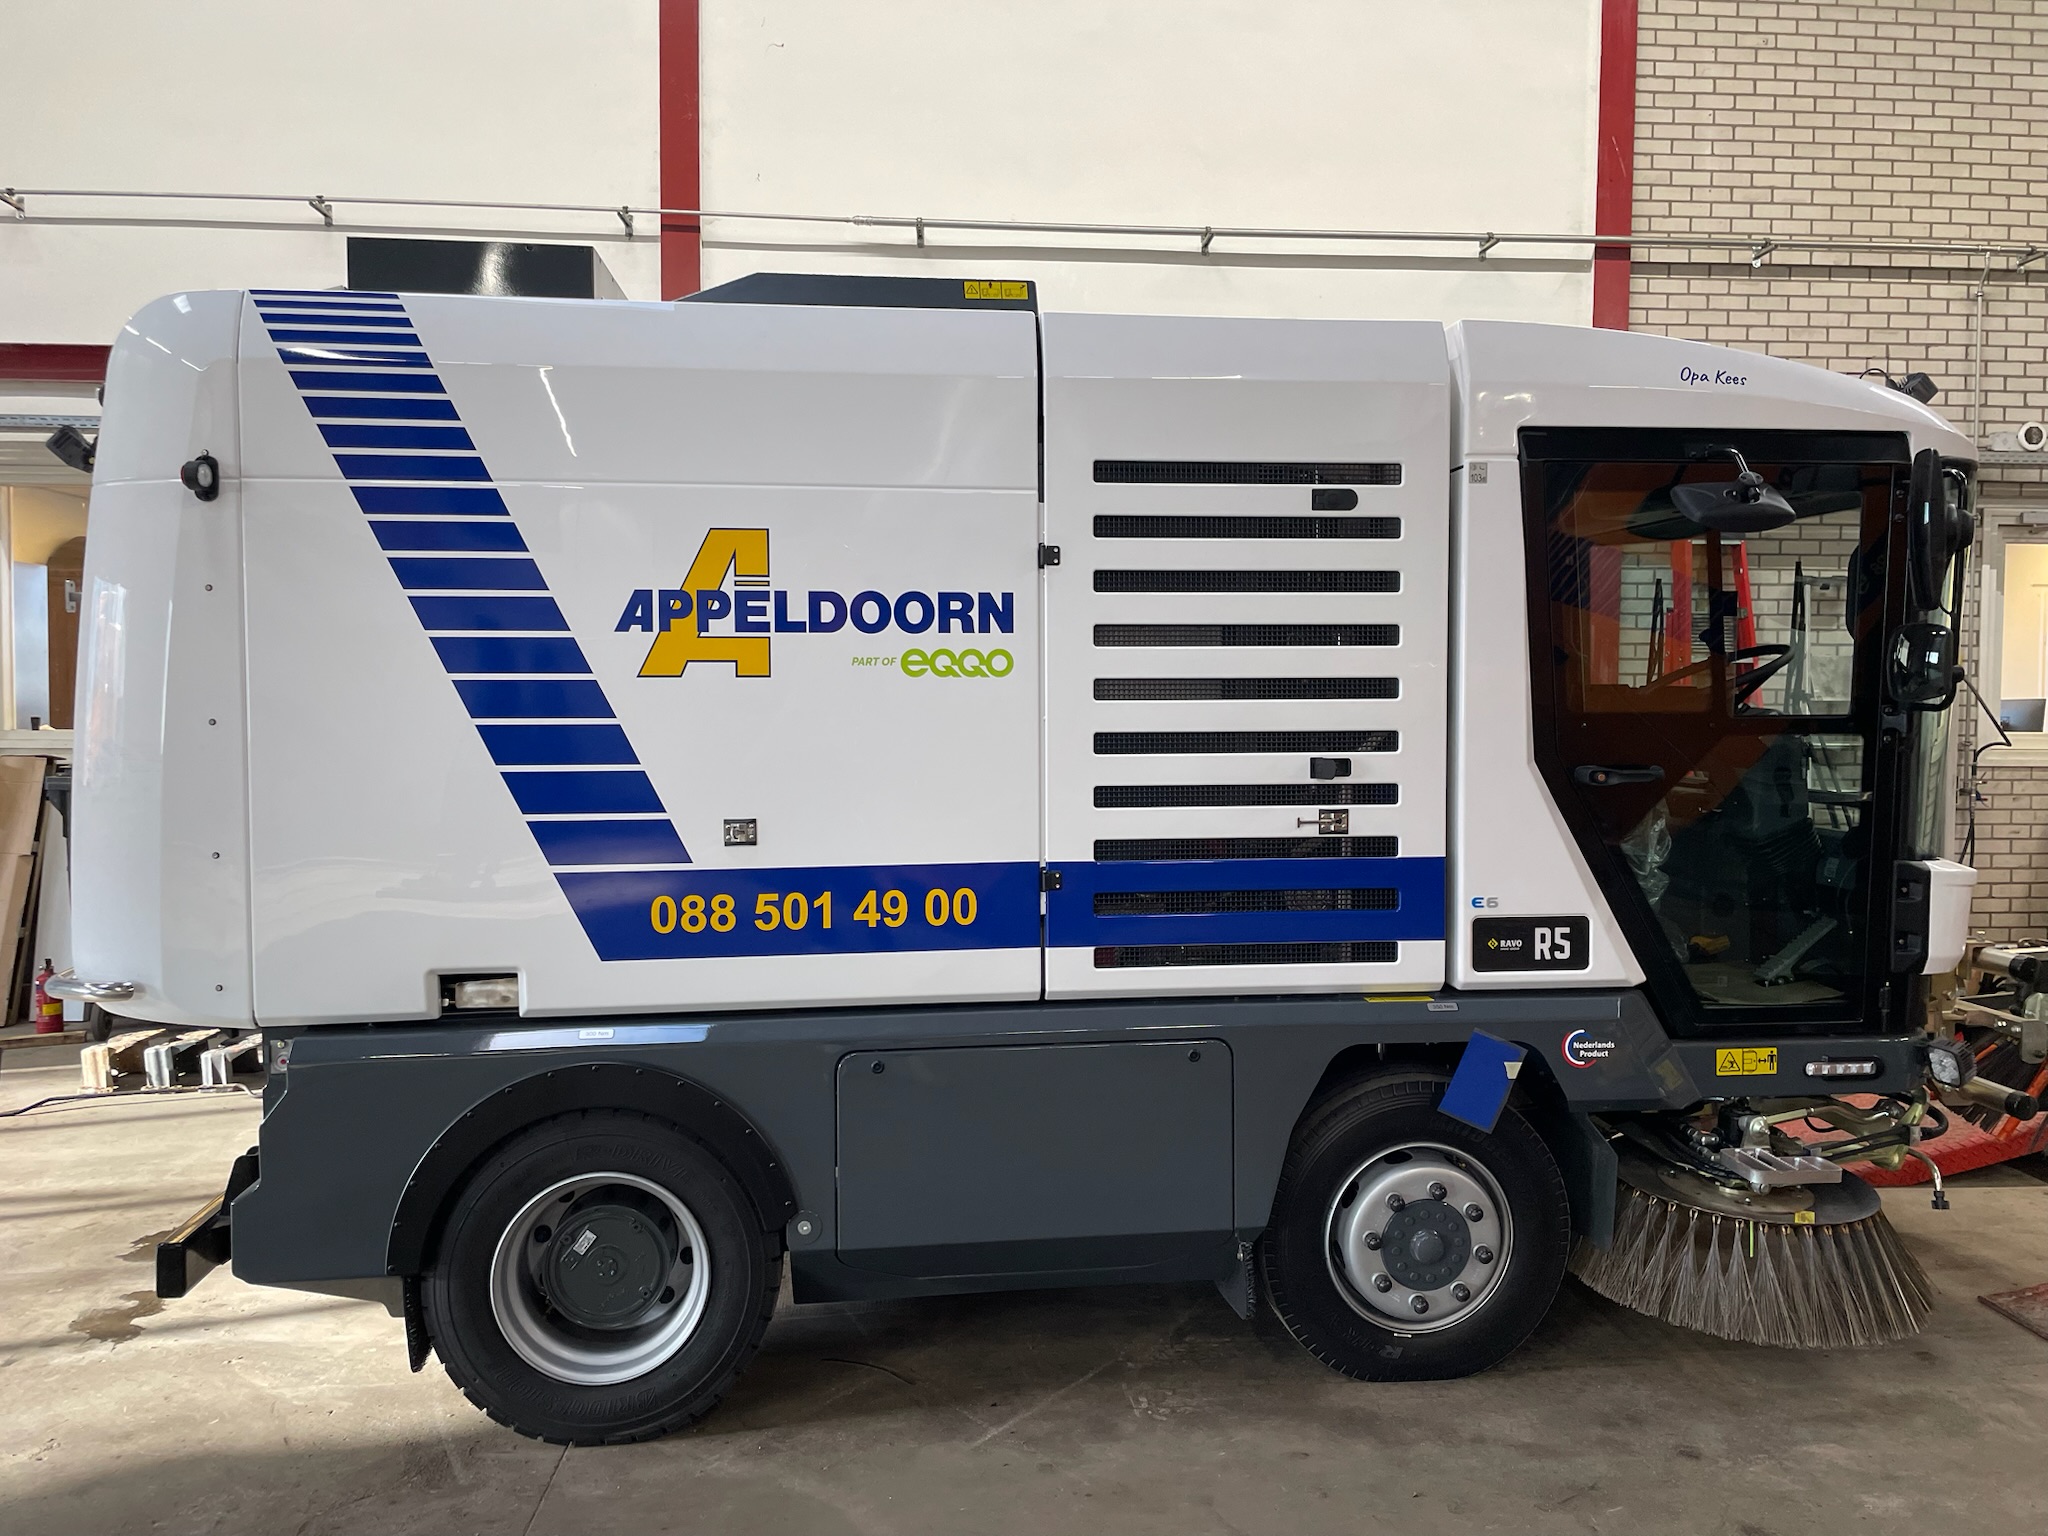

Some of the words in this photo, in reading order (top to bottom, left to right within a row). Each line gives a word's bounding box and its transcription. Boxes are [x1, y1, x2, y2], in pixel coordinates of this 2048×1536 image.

[1680, 366, 1710, 386] Opa
[1714, 369, 1748, 386] Kees
[614, 588, 1015, 635] APPELDOORN
[851, 656, 879, 667] PART
[881, 656, 897, 667] OF
[650, 893, 737, 934] 088
[754, 891, 832, 931] 501
[853, 889, 909, 928] 49
[924, 887, 978, 927] 00
[1471, 896, 1499, 909] E6
[1500, 939, 1523, 948] RAVO
[1534, 926, 1571, 961] R5
[1573, 1041, 1615, 1049] Nederlands
[1579, 1050, 1609, 1058] Product
